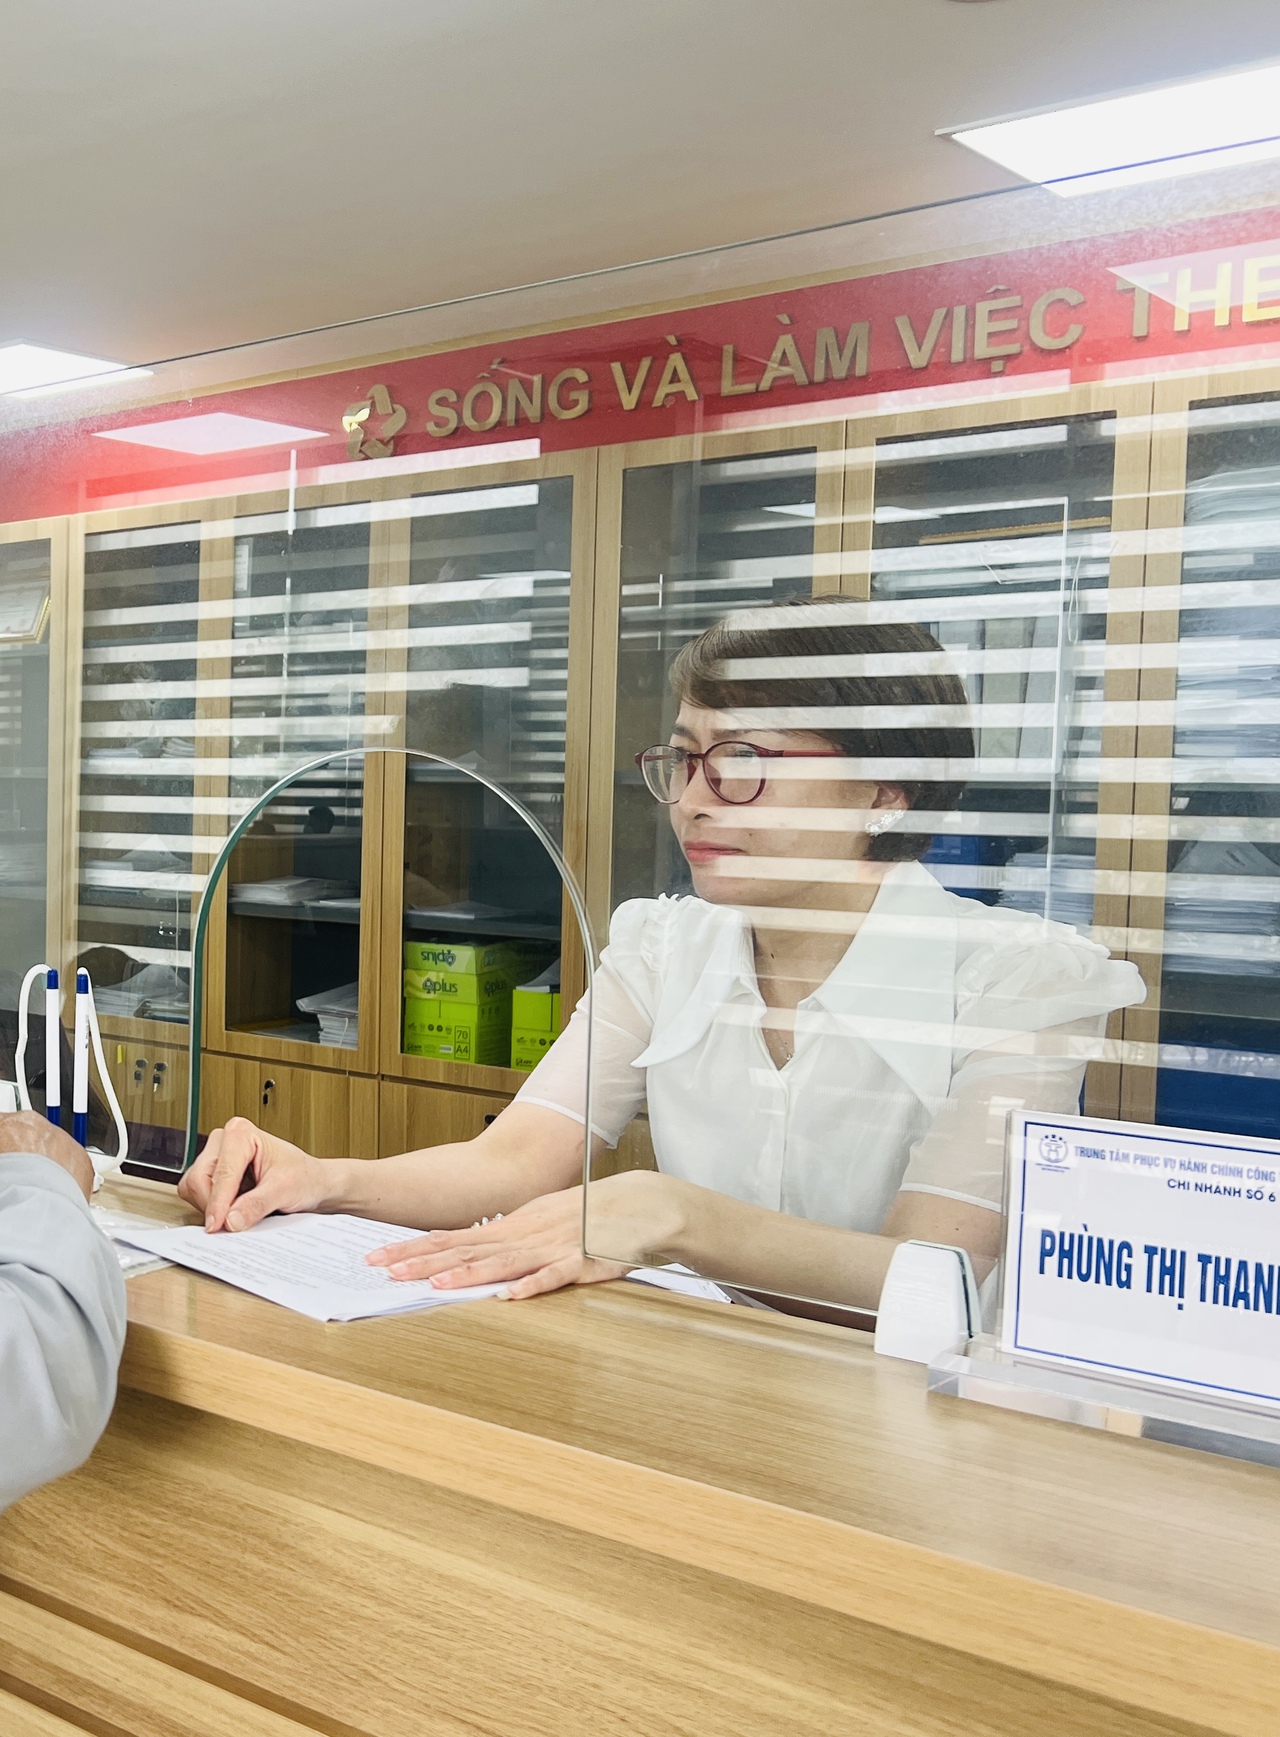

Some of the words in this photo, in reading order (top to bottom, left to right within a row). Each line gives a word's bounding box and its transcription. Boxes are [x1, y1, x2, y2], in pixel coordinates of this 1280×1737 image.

[425, 357, 591, 437] SỐNG
[610, 333, 700, 411] VÀ
[720, 313, 871, 398] LÀM
[894, 284, 1086, 374] VIỆC
[456, 1030, 469, 1040] 70
[455, 1044, 469, 1054] A4
[1074, 1145, 1106, 1160] TRUNG
[1167, 1178, 1190, 1191] CHI
[1194, 1180, 1241, 1198] NHÁNH
[1246, 1185, 1265, 1201] SỐ
[1268, 1191, 1276, 1203] 6
[1039, 1223, 1134, 1290] PHÙNG
[1144, 1244, 1187, 1311] THỊ
